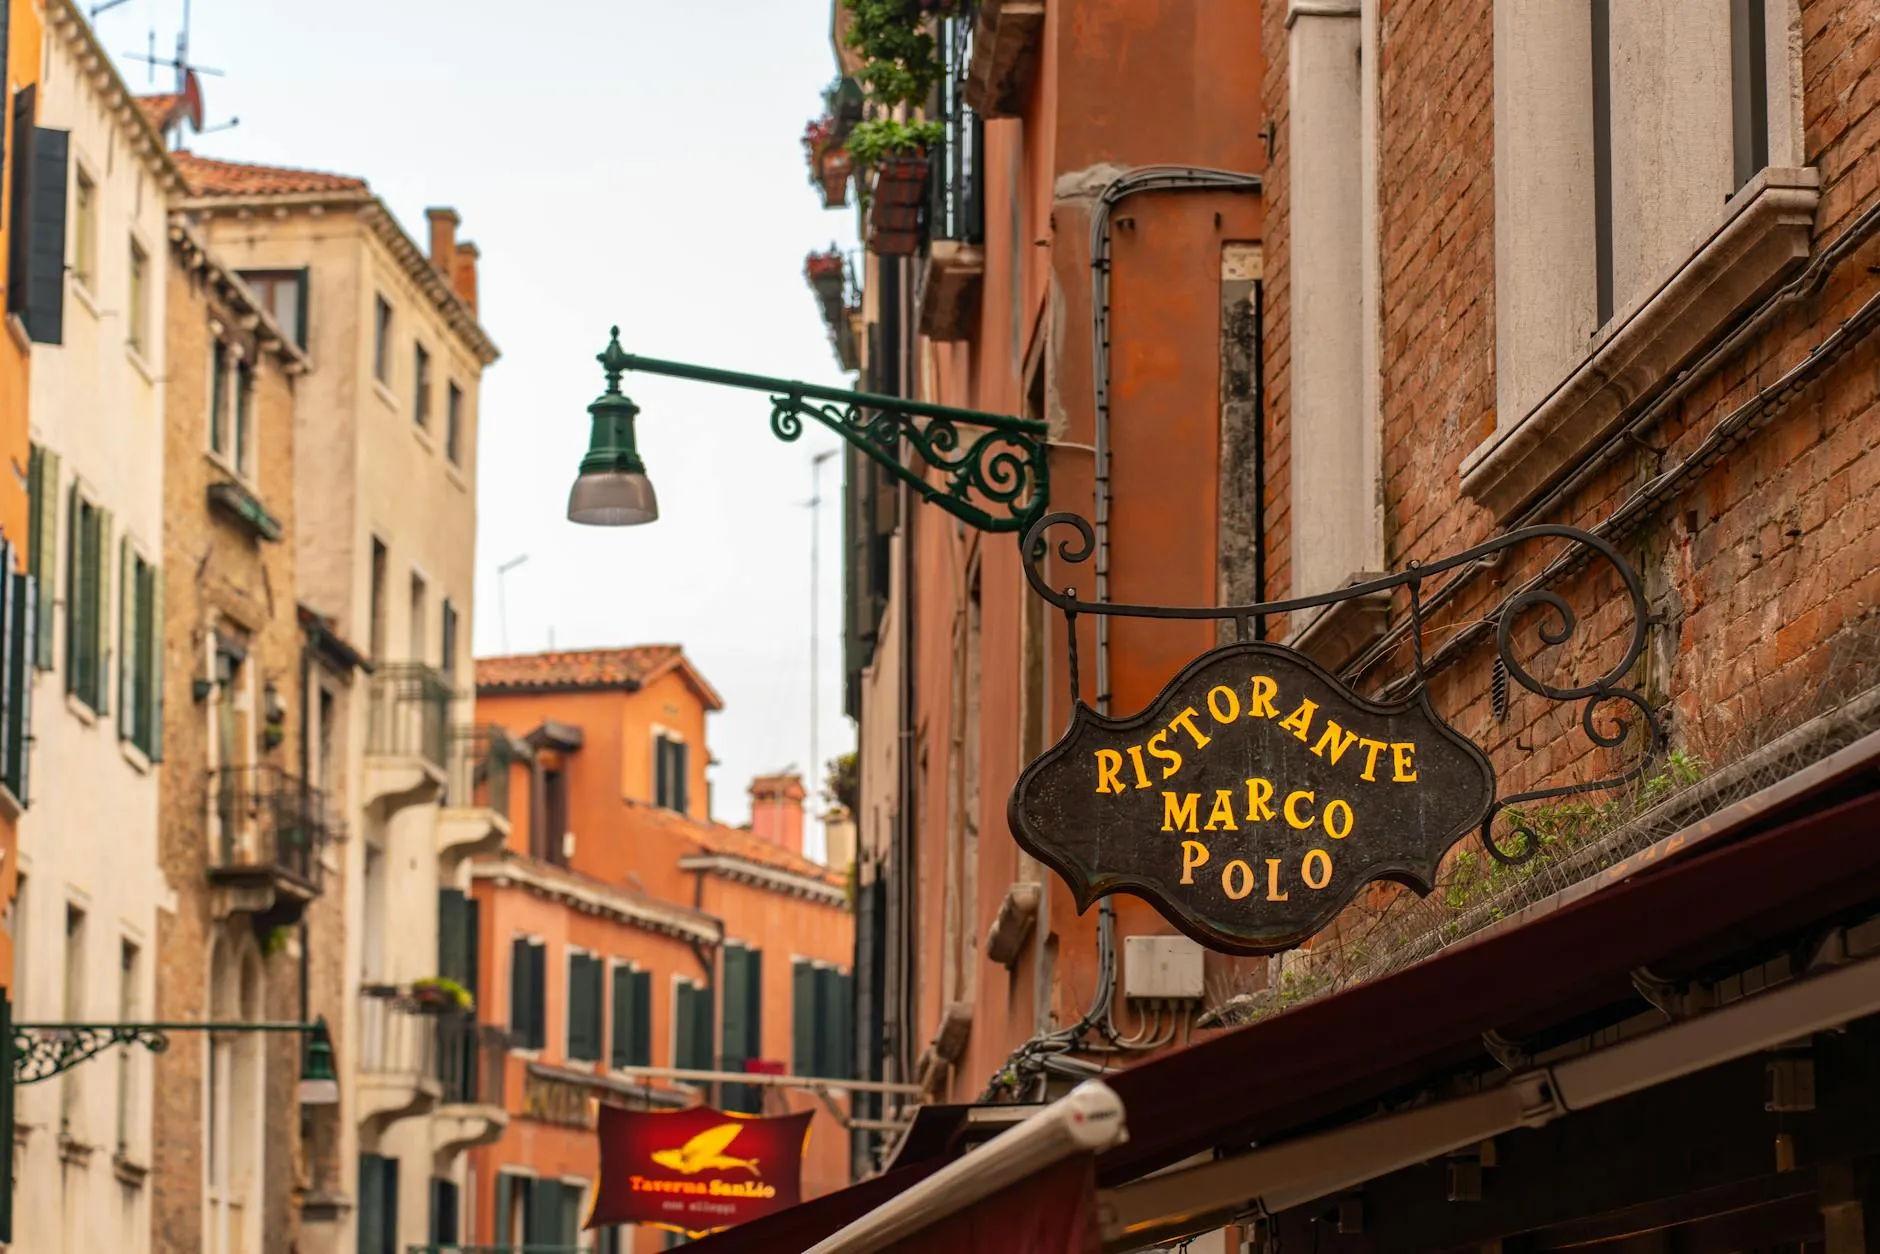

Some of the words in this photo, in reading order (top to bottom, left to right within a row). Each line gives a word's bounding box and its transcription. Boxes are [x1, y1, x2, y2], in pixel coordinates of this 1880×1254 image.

[1094, 675, 1418, 795] RISTORANTE
[1161, 777, 1354, 840] MARCO
[1179, 841, 1333, 902] POLO
[629, 1175, 707, 1195] Taverna
